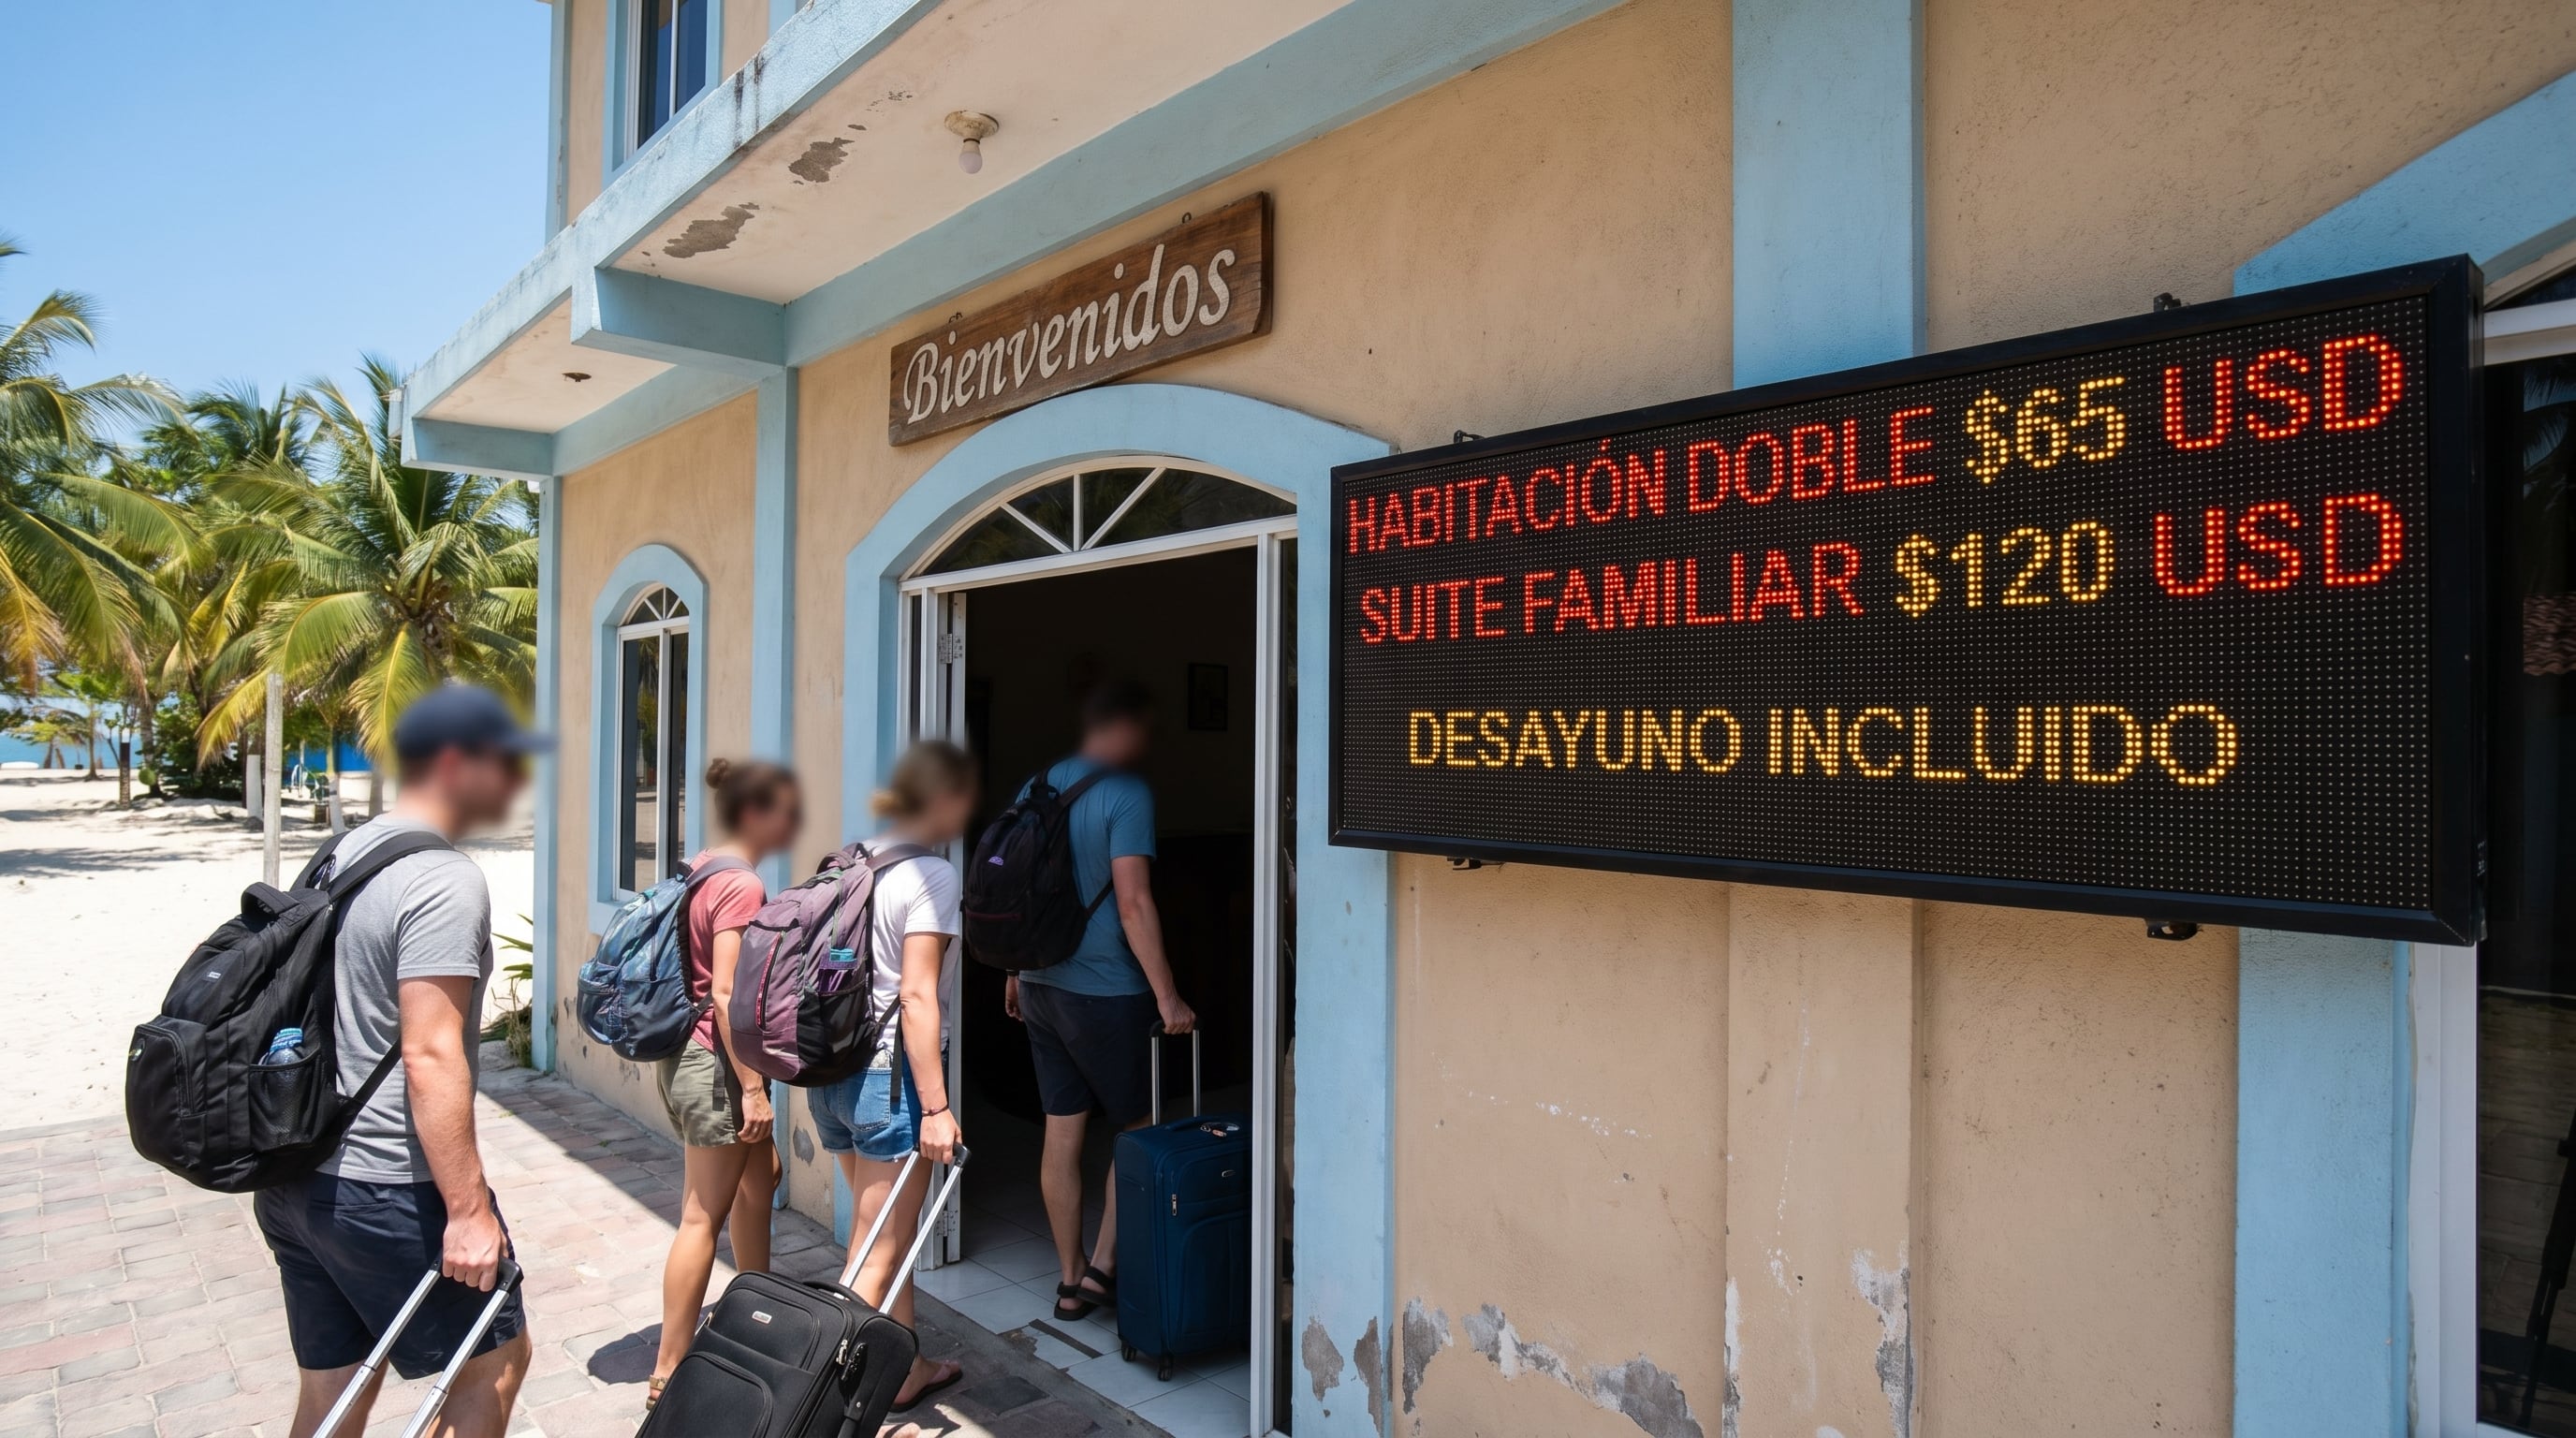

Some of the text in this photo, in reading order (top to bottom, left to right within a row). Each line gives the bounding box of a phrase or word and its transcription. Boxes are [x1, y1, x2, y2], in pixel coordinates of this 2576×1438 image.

[903, 243, 1236, 425] Bienvenidos
[1348, 334, 2403, 553] HABITACIÓN DOBLE $65 USD
[1358, 492, 2403, 643] SUITE FAMILIAR $120 USD
[1409, 703, 2238, 785] DESAYUNO INCLUIDO
